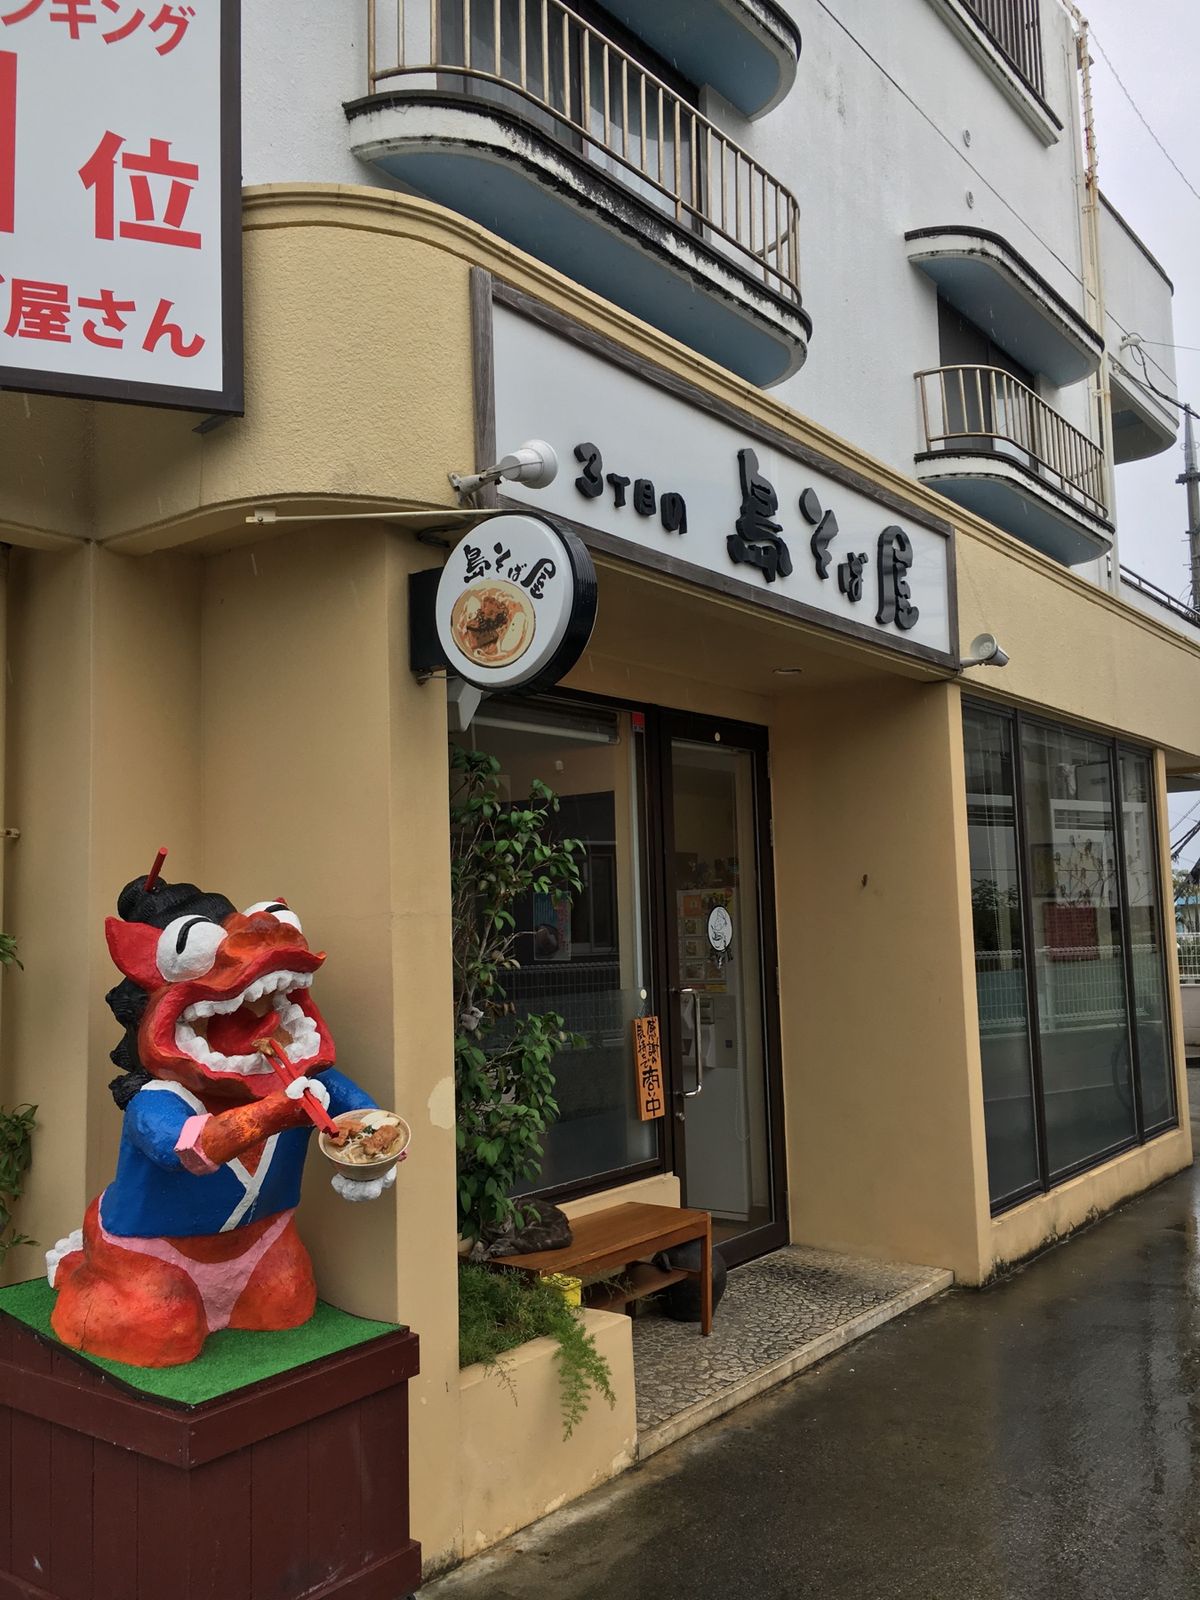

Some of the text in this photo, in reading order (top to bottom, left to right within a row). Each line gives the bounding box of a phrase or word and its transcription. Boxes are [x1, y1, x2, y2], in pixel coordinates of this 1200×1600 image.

[0, 274, 205, 357] 屋さん
[463, 542, 556, 599] 島そば屋
[726, 448, 919, 630] 島そば屋
[642, 1066, 660, 1116] 商い中
